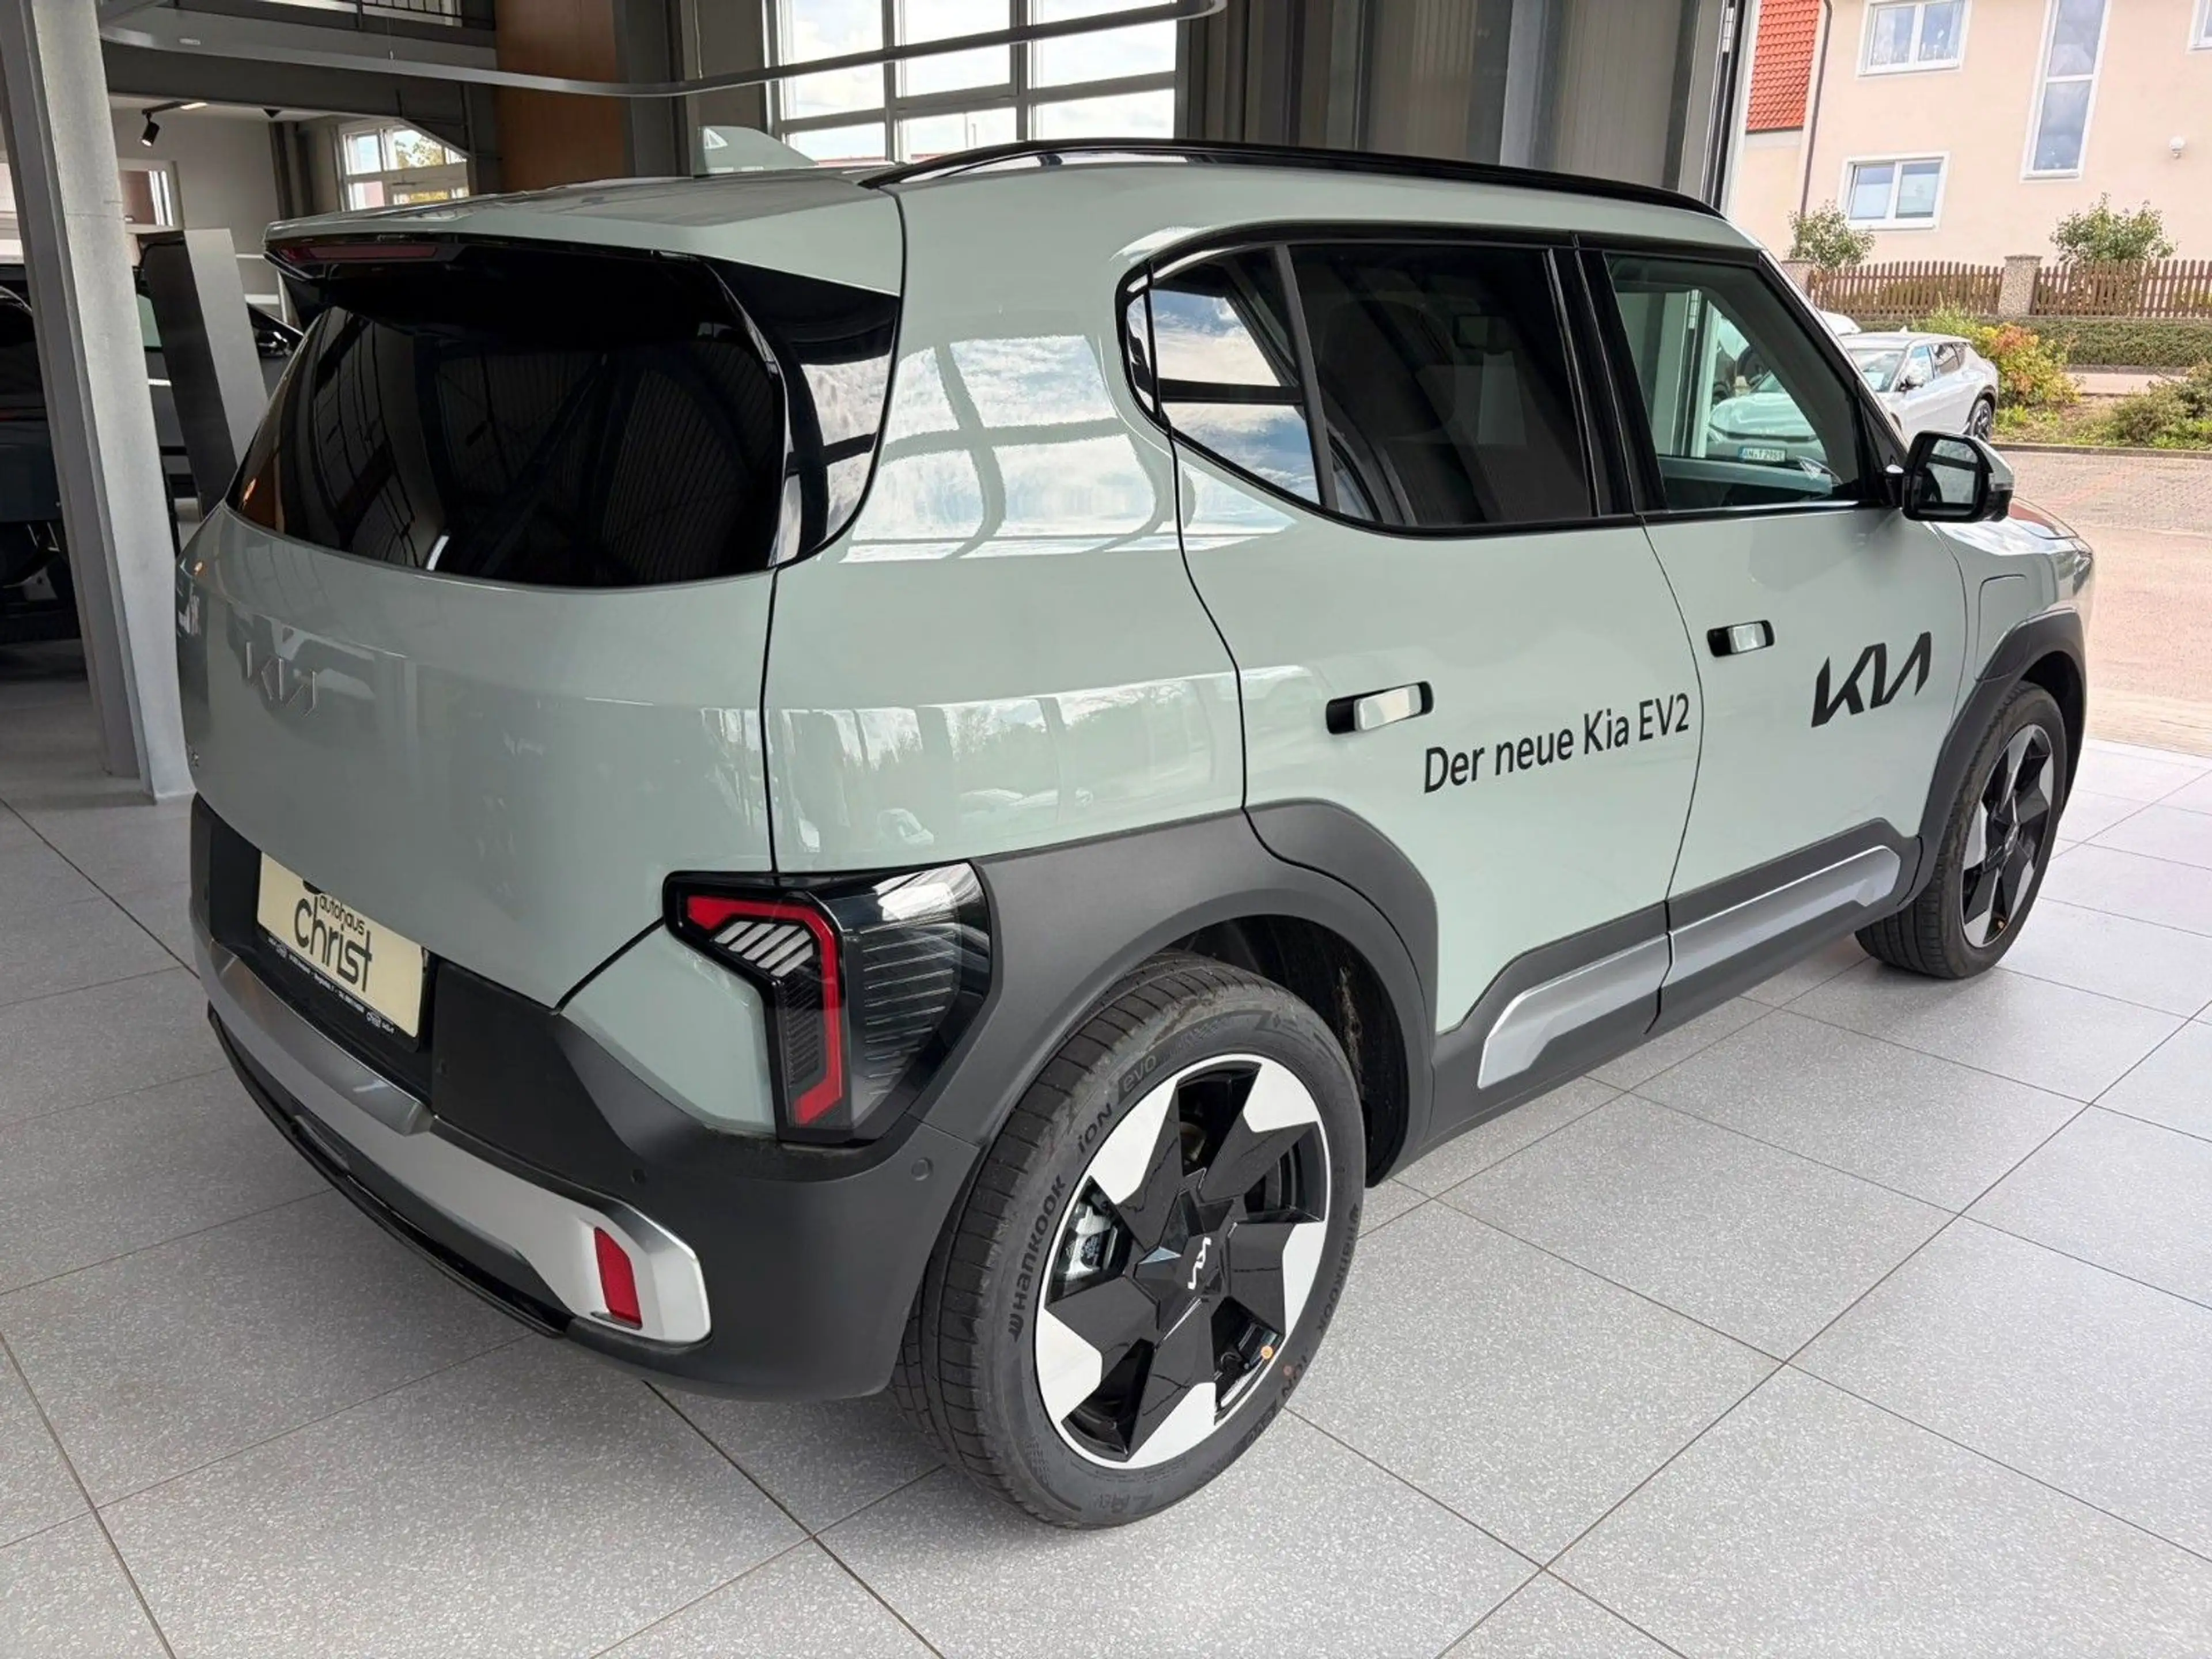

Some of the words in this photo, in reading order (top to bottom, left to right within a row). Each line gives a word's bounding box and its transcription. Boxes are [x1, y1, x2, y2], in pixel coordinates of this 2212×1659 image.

[1424, 746, 1485, 793] Der
[1495, 728, 1574, 776] neue
[1584, 708, 1630, 755] Kia
[1639, 692, 1690, 742] EV2
[294, 895, 373, 993] christ
[320, 895, 365, 936] autohaus
[1124, 1055, 1157, 1092] evo
